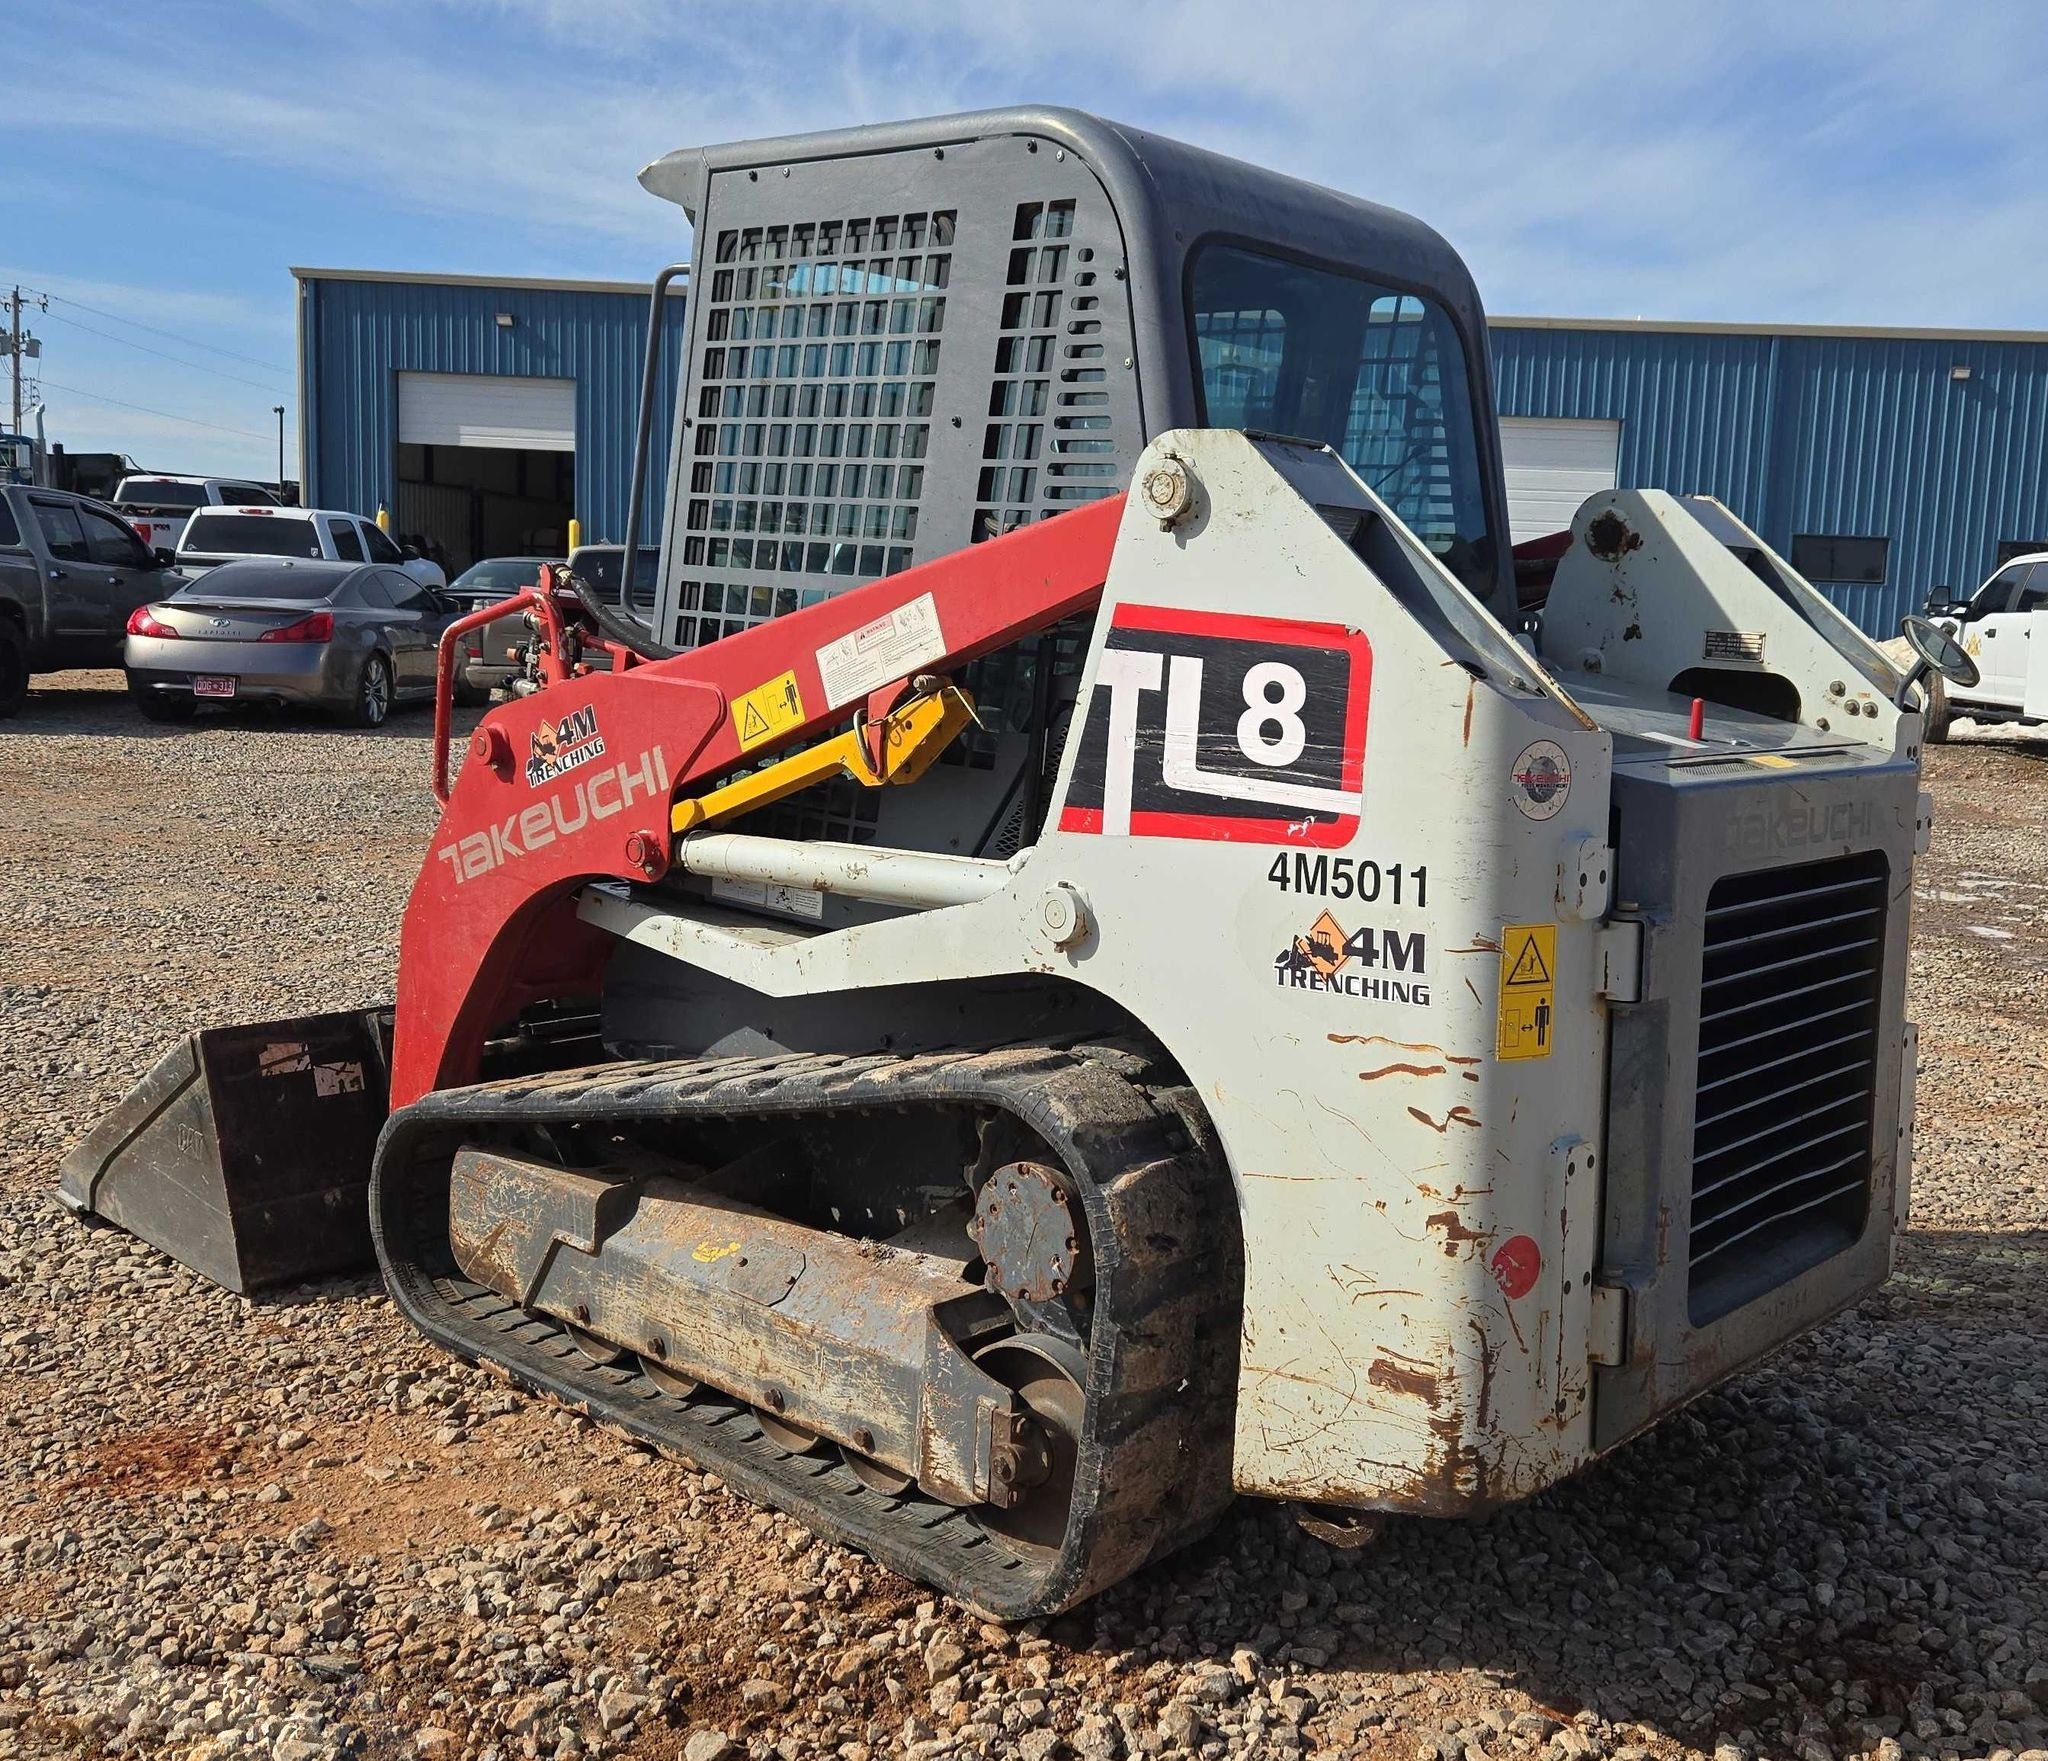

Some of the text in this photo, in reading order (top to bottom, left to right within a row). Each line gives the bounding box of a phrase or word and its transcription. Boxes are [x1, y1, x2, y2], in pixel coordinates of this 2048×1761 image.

[556, 704, 598, 748] 4M
[1093, 648, 1362, 836] TL8
[527, 739, 605, 787] TRENCHING
[1267, 851, 1428, 908] 4M5011
[1342, 927, 1426, 974] 4M
[1273, 965, 1431, 1006] TRENCHING
